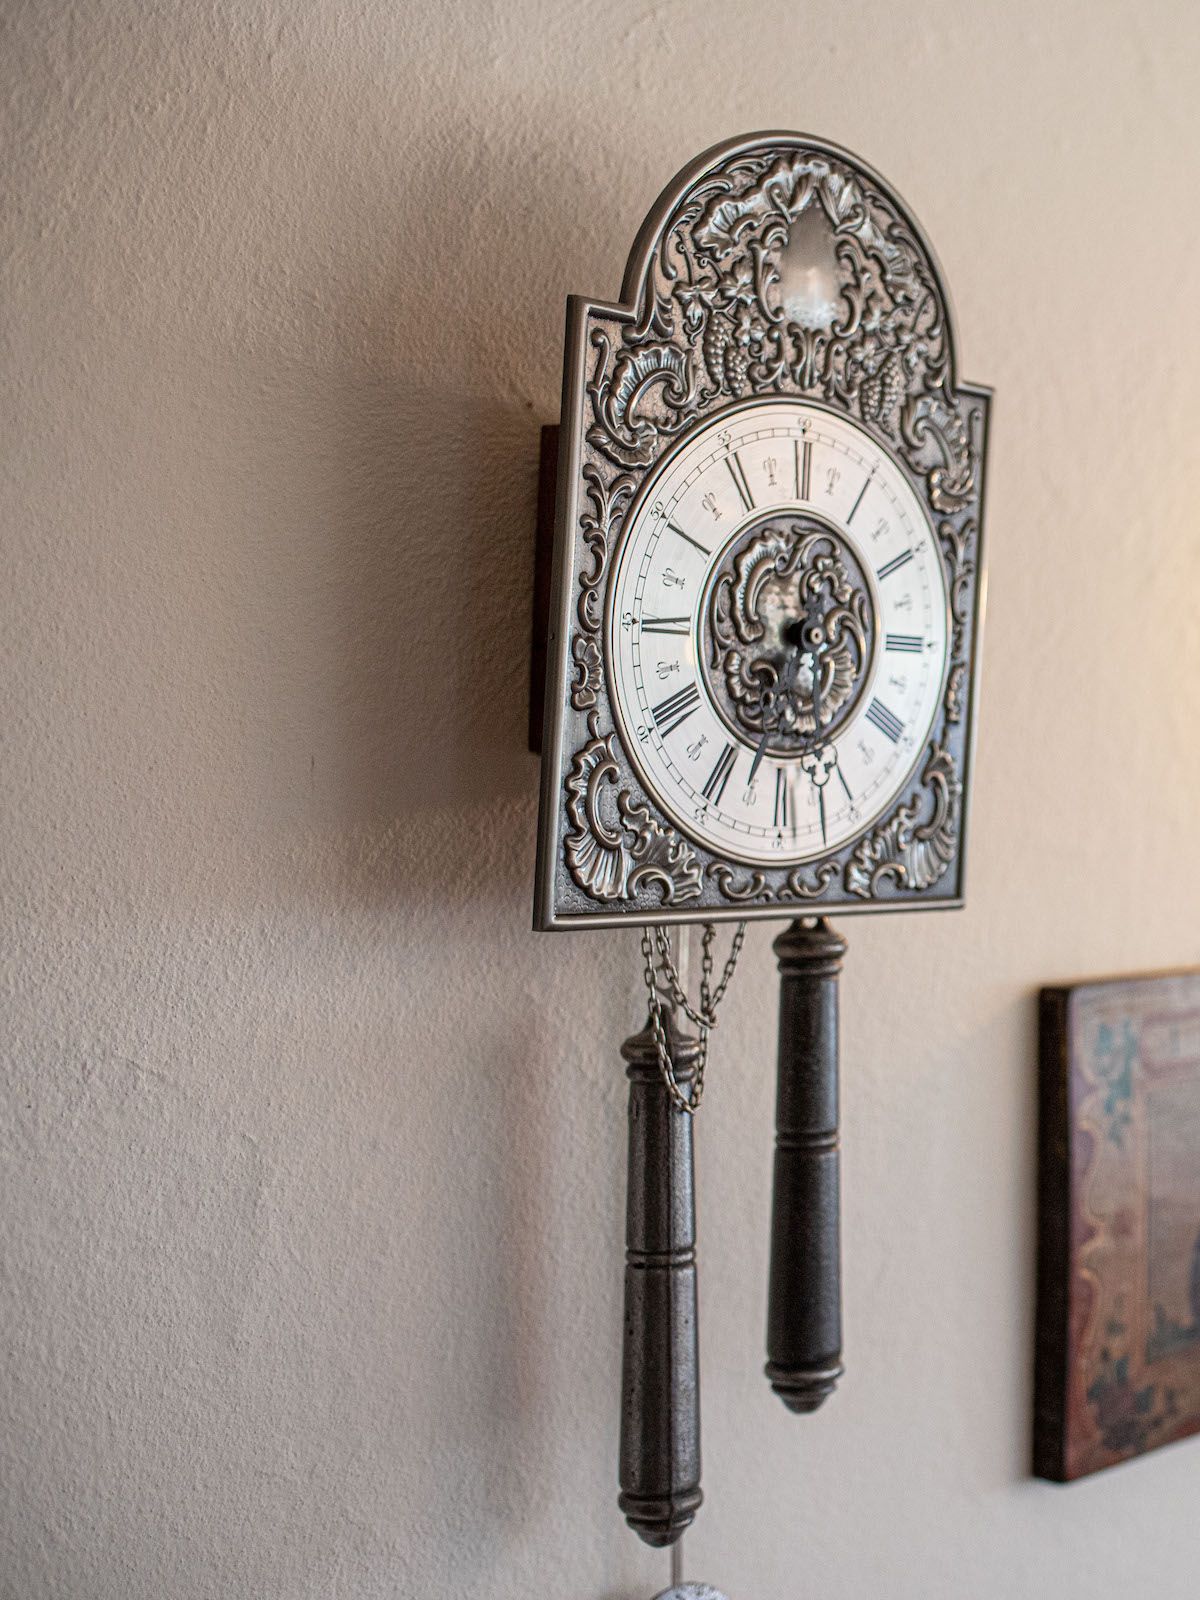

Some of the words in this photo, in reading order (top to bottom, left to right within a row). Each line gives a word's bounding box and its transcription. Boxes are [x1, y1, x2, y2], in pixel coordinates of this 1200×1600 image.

[717, 430, 732, 446] 55
[722, 451, 757, 517] XI
[650, 501, 664, 521] 50
[846, 477, 871, 525] I
[664, 514, 713, 564] X
[876, 548, 915, 581] II
[622, 612, 632, 632] 45
[640, 610, 692, 637] IX
[885, 634, 924, 654] III
[649, 680, 704, 740] VIII
[864, 696, 906, 745] IIII
[636, 725, 649, 745] 40
[701, 741, 740, 807] VII
